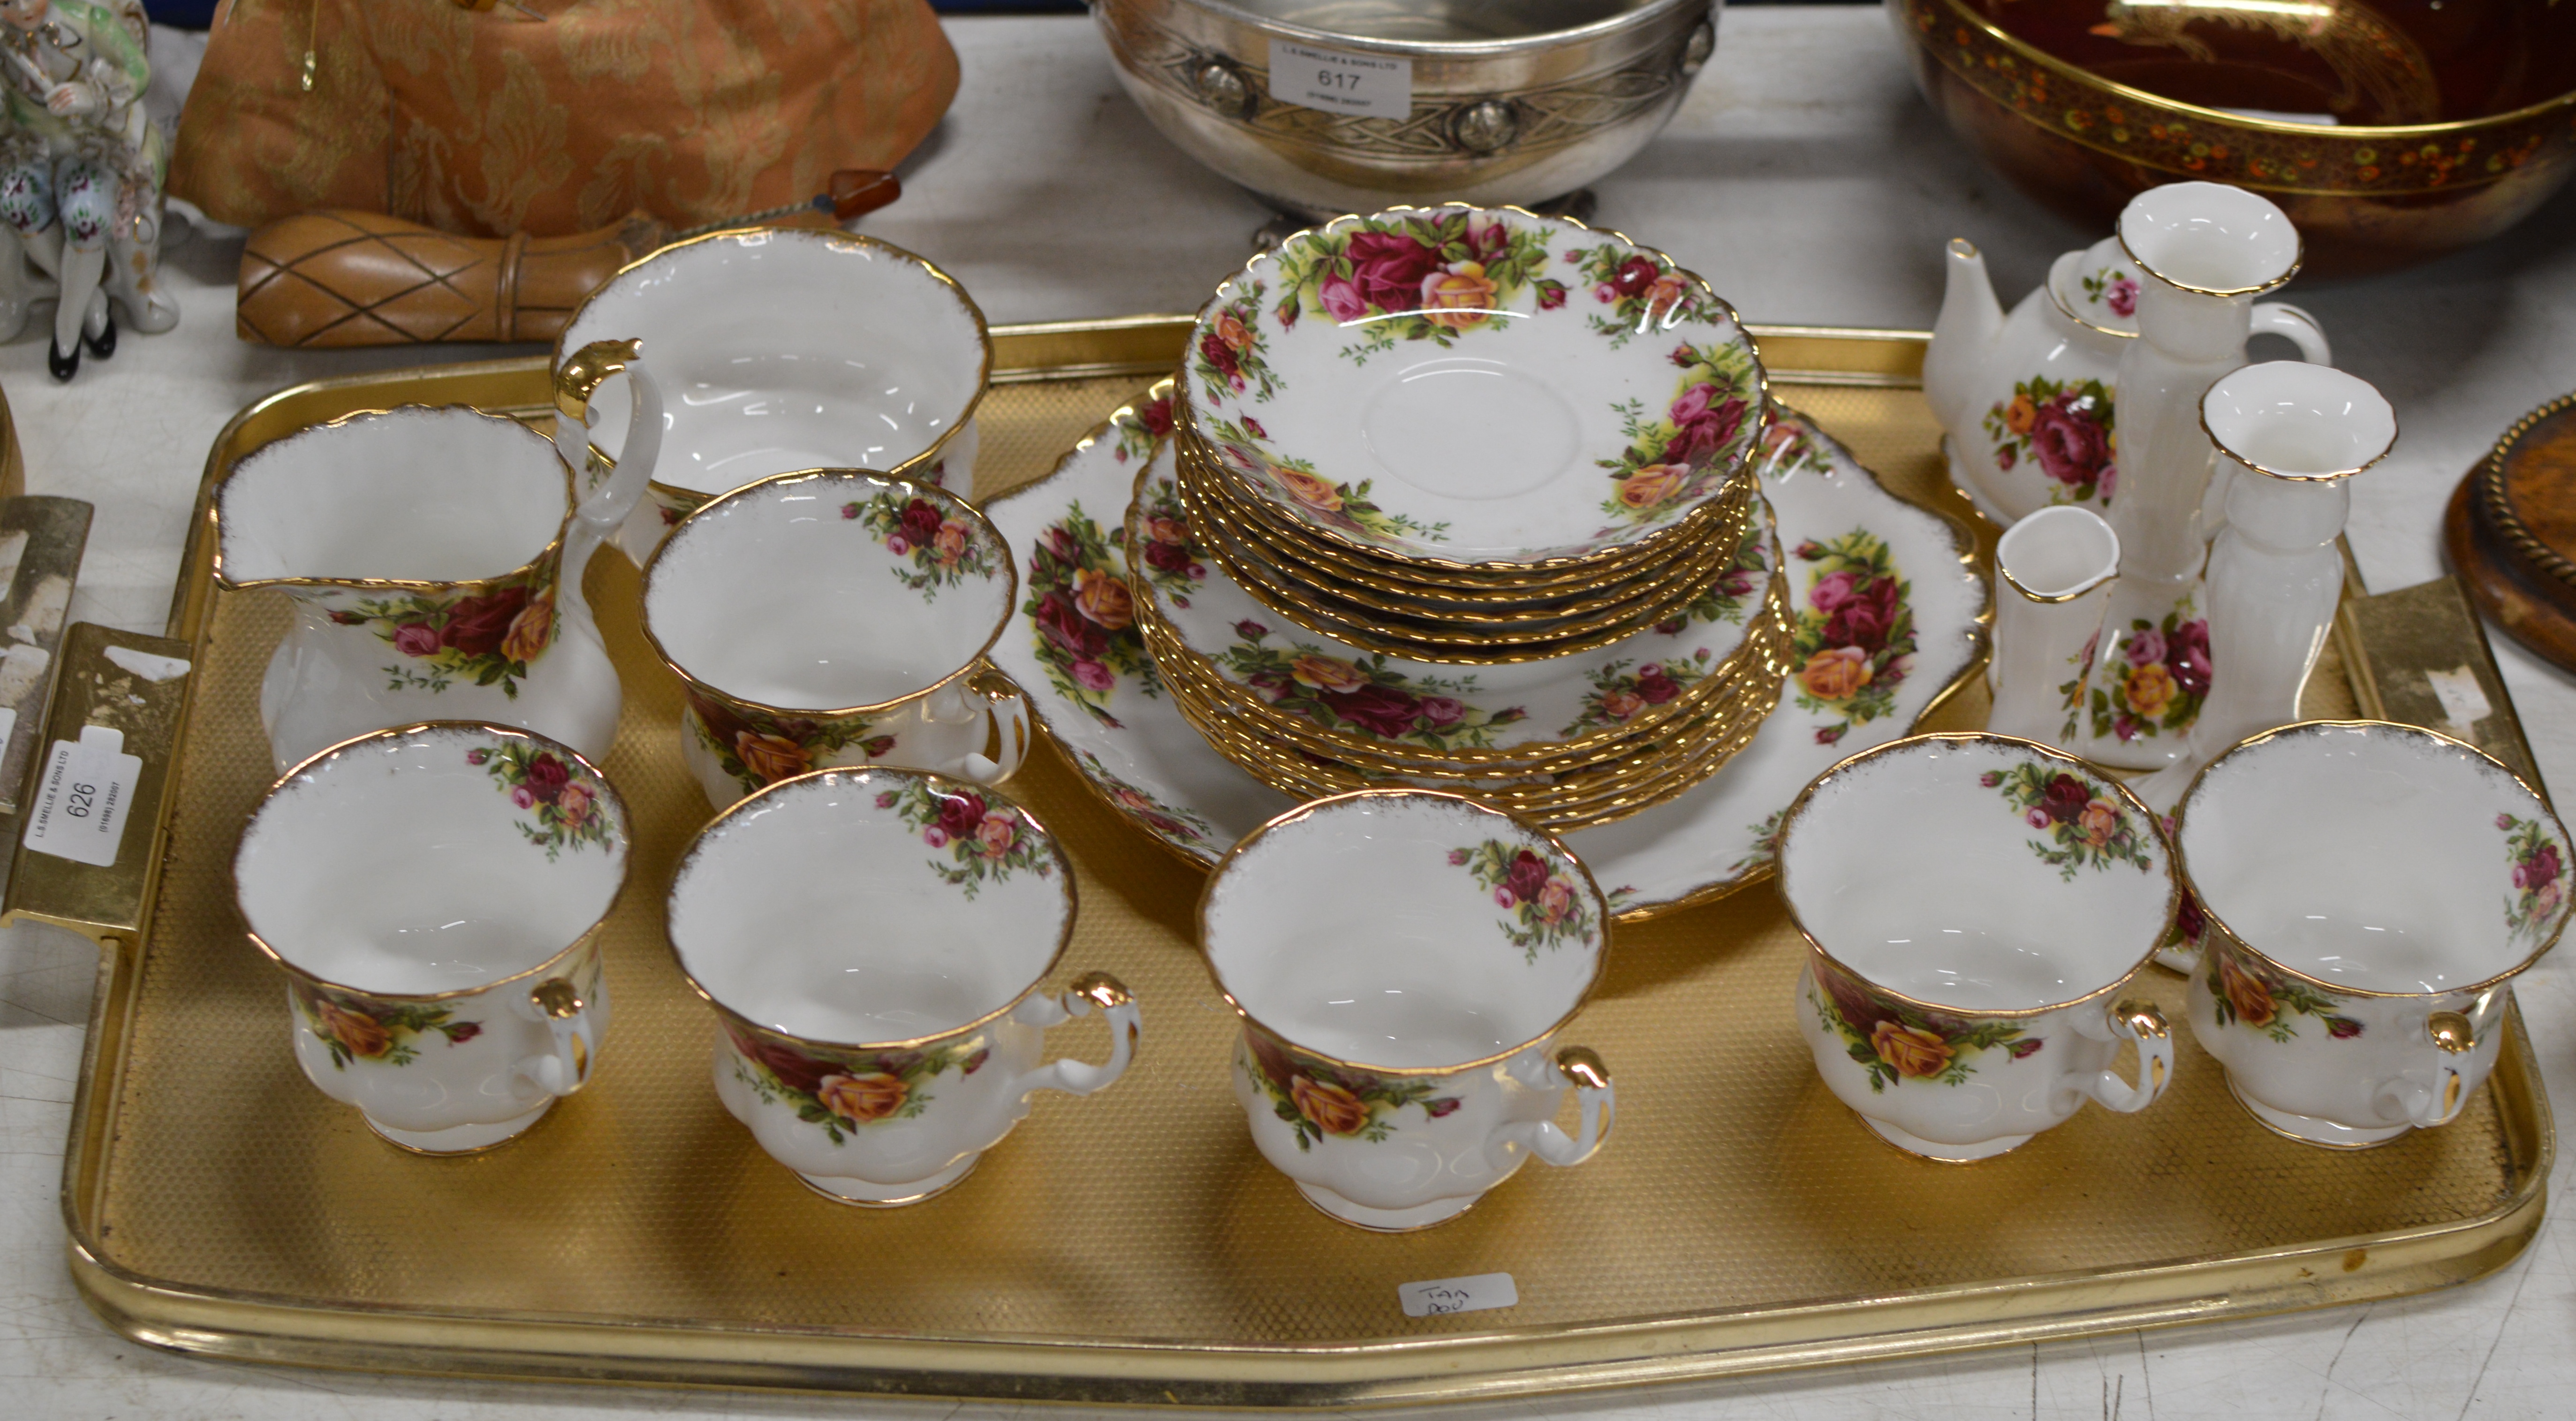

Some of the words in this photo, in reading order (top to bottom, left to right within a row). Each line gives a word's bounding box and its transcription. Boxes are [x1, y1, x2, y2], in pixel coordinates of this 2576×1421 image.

[1318, 70, 1360, 89] 617
[52, 766, 64, 786] SONS
[58, 751, 69, 764] LTD
[67, 783, 96, 818] 626
